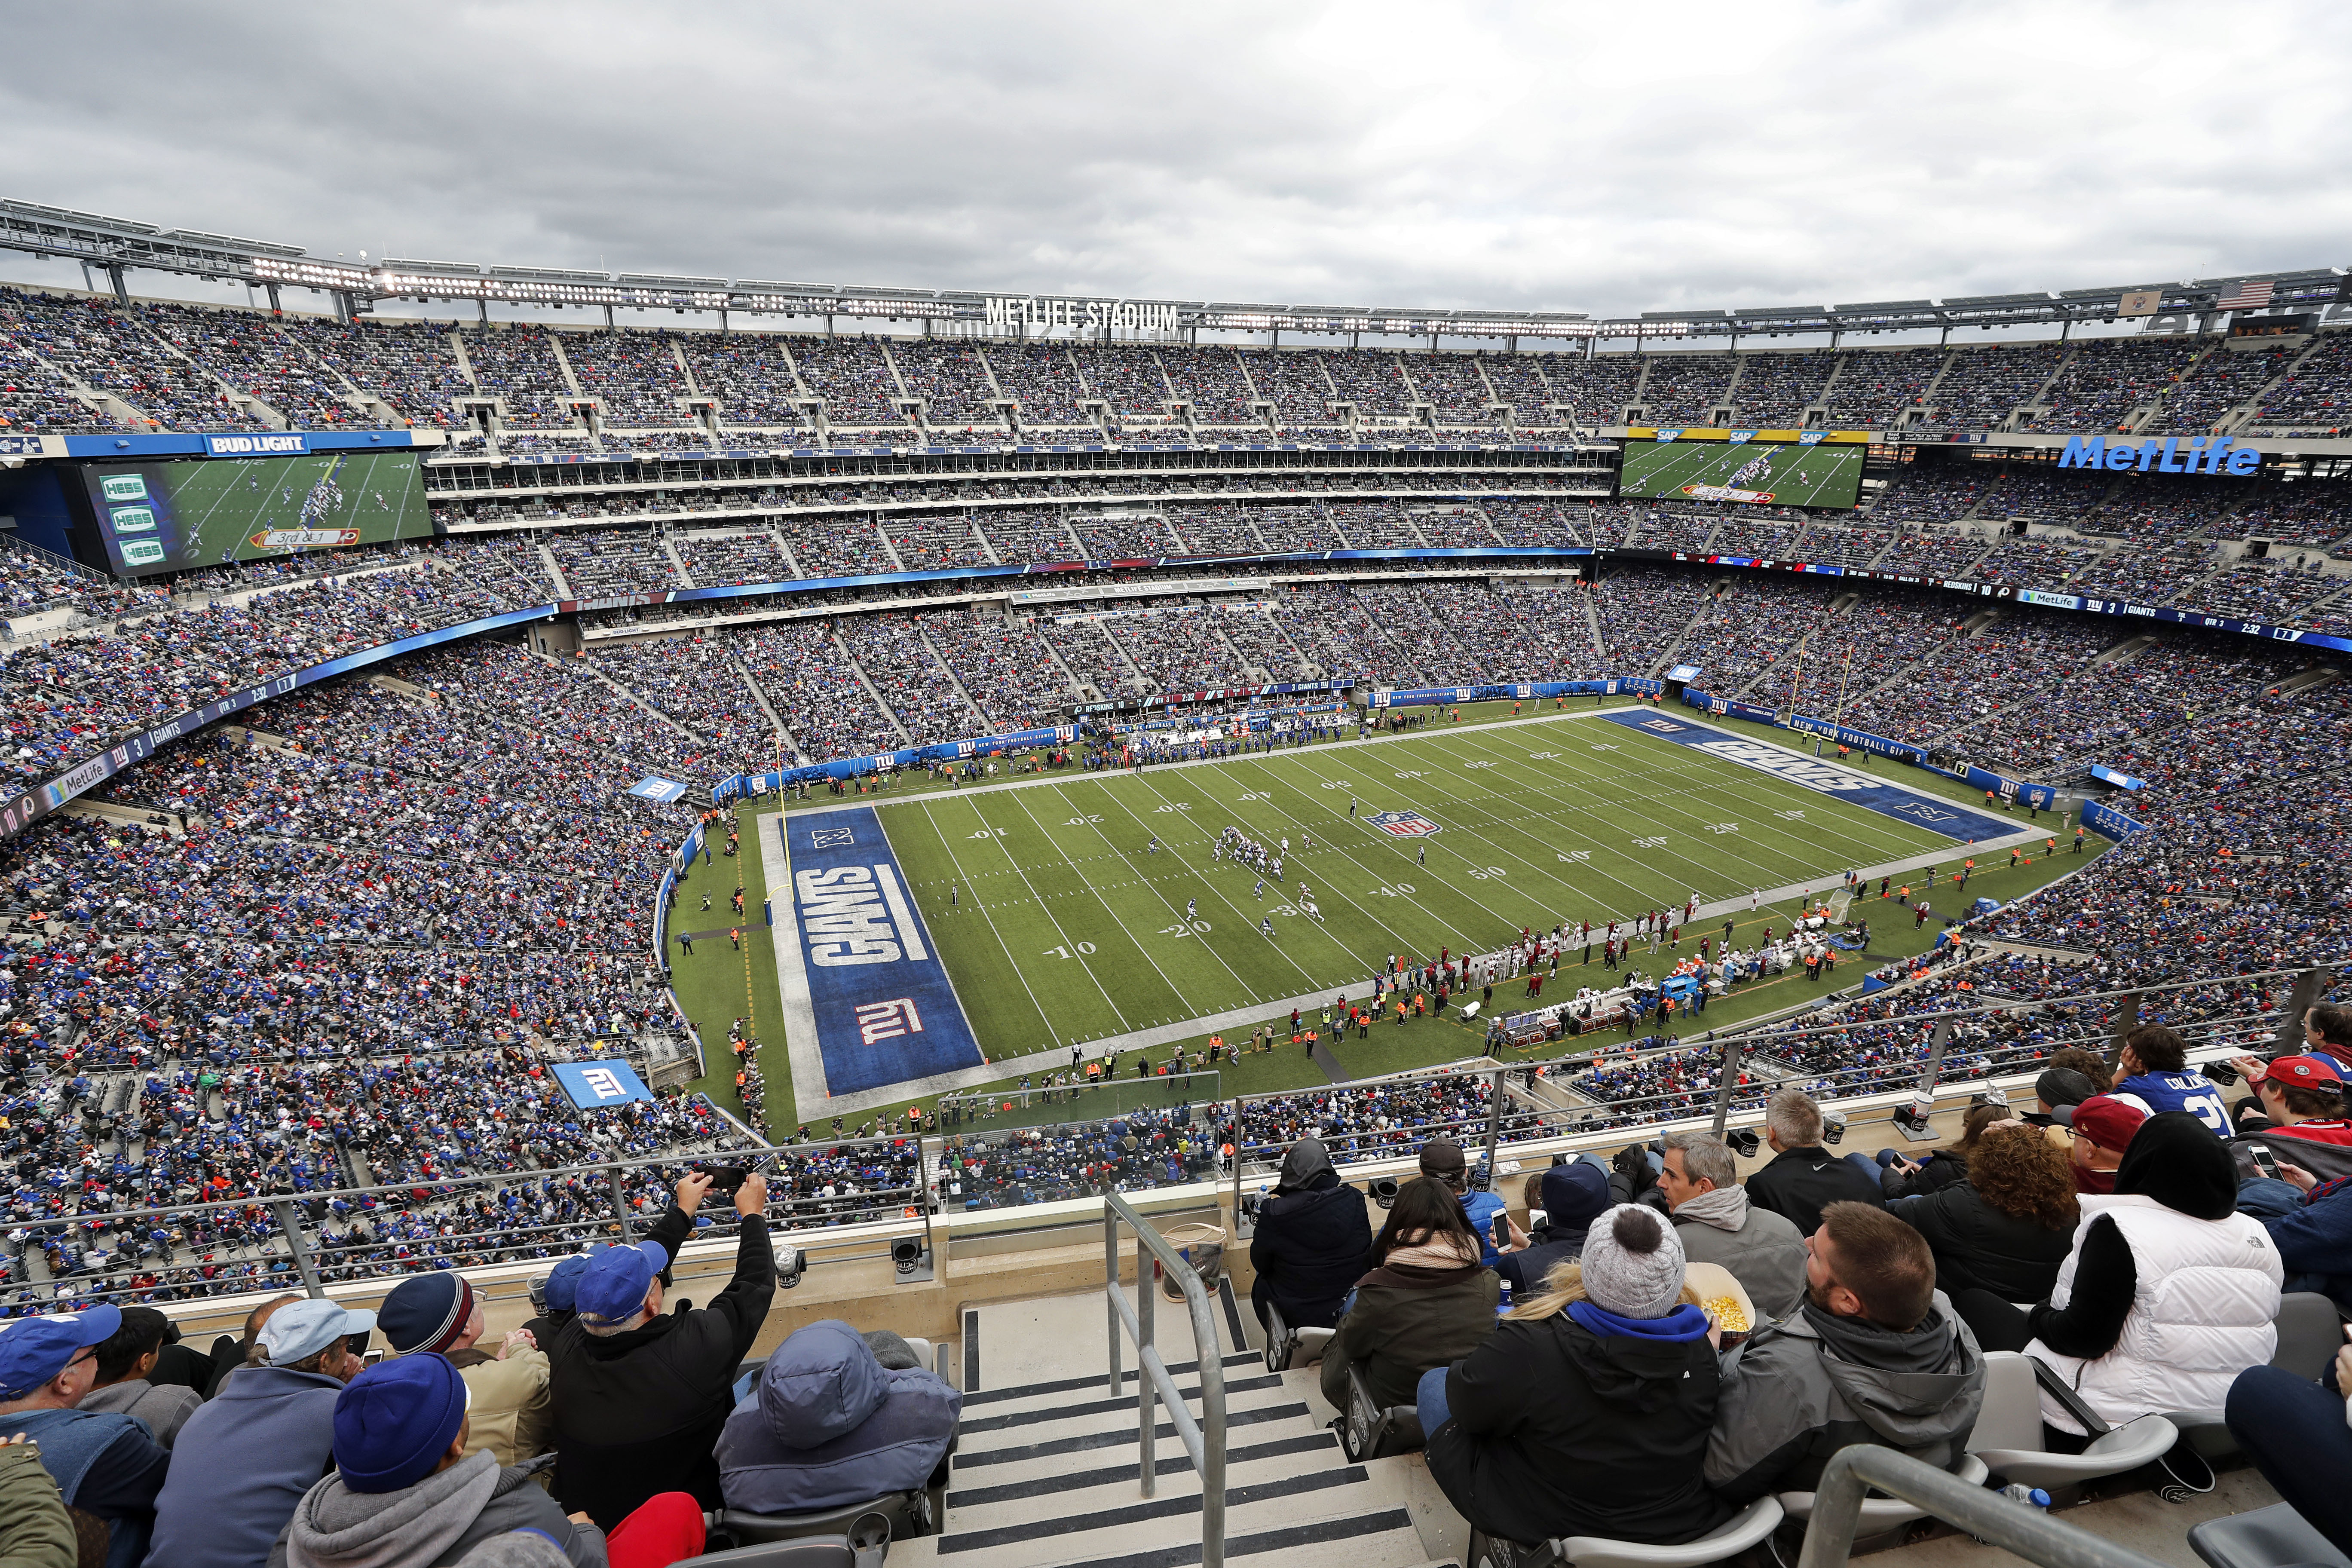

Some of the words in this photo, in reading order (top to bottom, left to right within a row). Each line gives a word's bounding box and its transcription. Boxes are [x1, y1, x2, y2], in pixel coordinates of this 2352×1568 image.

[986, 298, 1078, 328] METLIFE
[1086, 301, 1176, 331] STADIUM
[1658, 431, 1678, 440] SAP
[1730, 432, 1752, 442] SAP
[1800, 433, 1822, 443] SAP
[1969, 434, 1981, 443] ny
[211, 437, 253, 453] BUD
[251, 436, 303, 451] LIGHT
[2058, 435, 2262, 476] MetLife
[105, 482, 143, 495] HESS
[115, 513, 152, 527] HESS
[277, 533, 300, 543] 3rd
[125, 545, 161, 559] HESS
[1943, 580, 1972, 591] REDSKINS
[1981, 585, 1992, 596] 10
[2037, 594, 2073, 605] MetLife
[2086, 599, 2103, 612] ny
[2108, 602, 2116, 613] 3
[2128, 605, 2156, 617] GIANTS
[2205, 618, 2217, 626] QTR
[2241, 623, 2261, 635] 2:32
[1674, 667, 1696, 677] ny
[1298, 682, 1318, 690] GIANTS
[1516, 685, 1531, 698] ny
[251, 686, 268, 702] 2:32
[1182, 693, 1195, 702] 2:32
[1374, 693, 1390, 707] ny
[1455, 688, 1470, 701] ny
[218, 701, 230, 714] QTR
[231, 698, 236, 707] 3
[1086, 703, 1114, 713] REDSKINS
[1712, 699, 1727, 714] ny
[1746, 707, 1773, 717] FOOTBALL.COM
[1640, 719, 1687, 733] ny
[153, 722, 181, 744] GIANTS
[1035, 732, 1054, 741] GIANTS
[1054, 726, 1074, 743] ny
[1794, 720, 1813, 731] NEW
[1818, 725, 1839, 738] YORK
[1843, 732, 1885, 751] FOOTBALL
[133, 738, 143, 757] 3
[957, 741, 976, 757] ny
[1591, 743, 1617, 751] 10
[111, 745, 130, 769] ny
[1529, 751, 1560, 760] 20
[1464, 760, 1495, 770] 30
[1701, 741, 1883, 791] GIANTS
[66, 764, 103, 793] MetLife
[1395, 770, 1424, 779] 40
[2107, 771, 2129, 784] GIANTS
[641, 781, 675, 798] ny
[1321, 780, 1352, 790] 50
[1244, 791, 1272, 801] 40
[1158, 802, 1192, 812] 30
[4, 808, 18, 833] 10
[1070, 814, 1104, 826] 20
[1773, 809, 1802, 821] 10
[1382, 820, 1436, 836] NFL
[1704, 822, 1735, 835] 20
[2095, 815, 2107, 824] WORLD
[2107, 822, 2129, 835] CHAMPIONS
[694, 827, 704, 848] ny
[974, 827, 1008, 839] 10
[1632, 836, 1663, 849] 30
[1557, 850, 1587, 864] 40
[1467, 866, 1507, 880] 50
[1378, 882, 1417, 898] 40
[795, 865, 902, 967] GIANTS
[1168, 920, 1212, 938] 20
[1056, 941, 1096, 959] 10
[854, 997, 924, 1046] ny
[581, 1068, 627, 1099] ny
[2164, 1073, 2211, 1090] COLLINS
[1211, 1106, 1217, 1114] 17
[2183, 1094, 2236, 1140] 21
